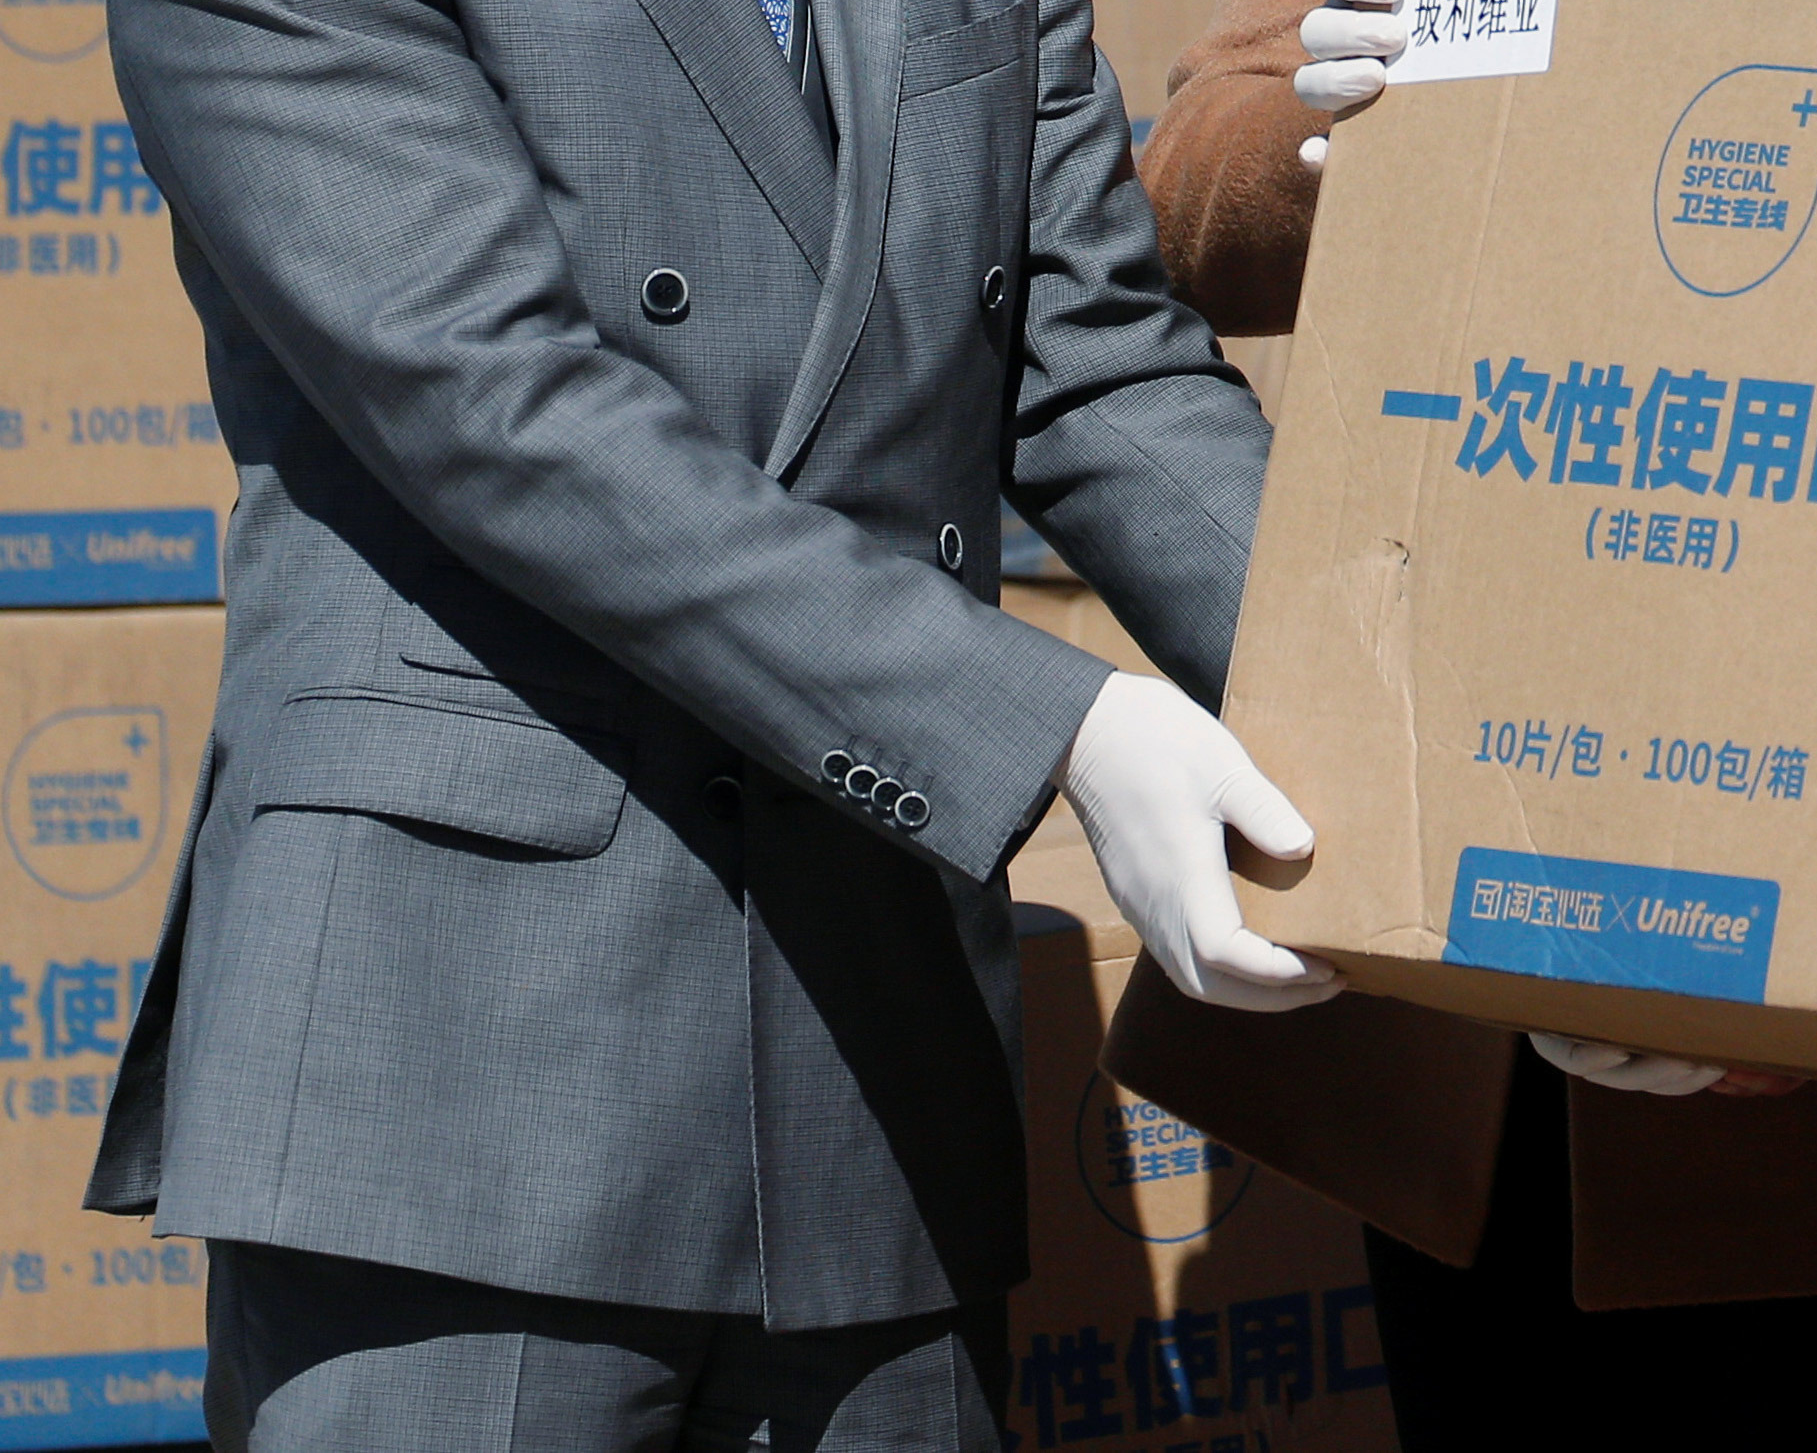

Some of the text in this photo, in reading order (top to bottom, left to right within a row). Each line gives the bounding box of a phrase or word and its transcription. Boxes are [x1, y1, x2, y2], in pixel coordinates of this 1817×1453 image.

[1687, 138, 1791, 167] HYGIENE
[1681, 165, 1776, 194] SPECIAL
[1672, 192, 1789, 232] 卫生专线
[1584, 507, 1741, 573] (非医用)
[1636, 897, 1750, 944] Unifree
